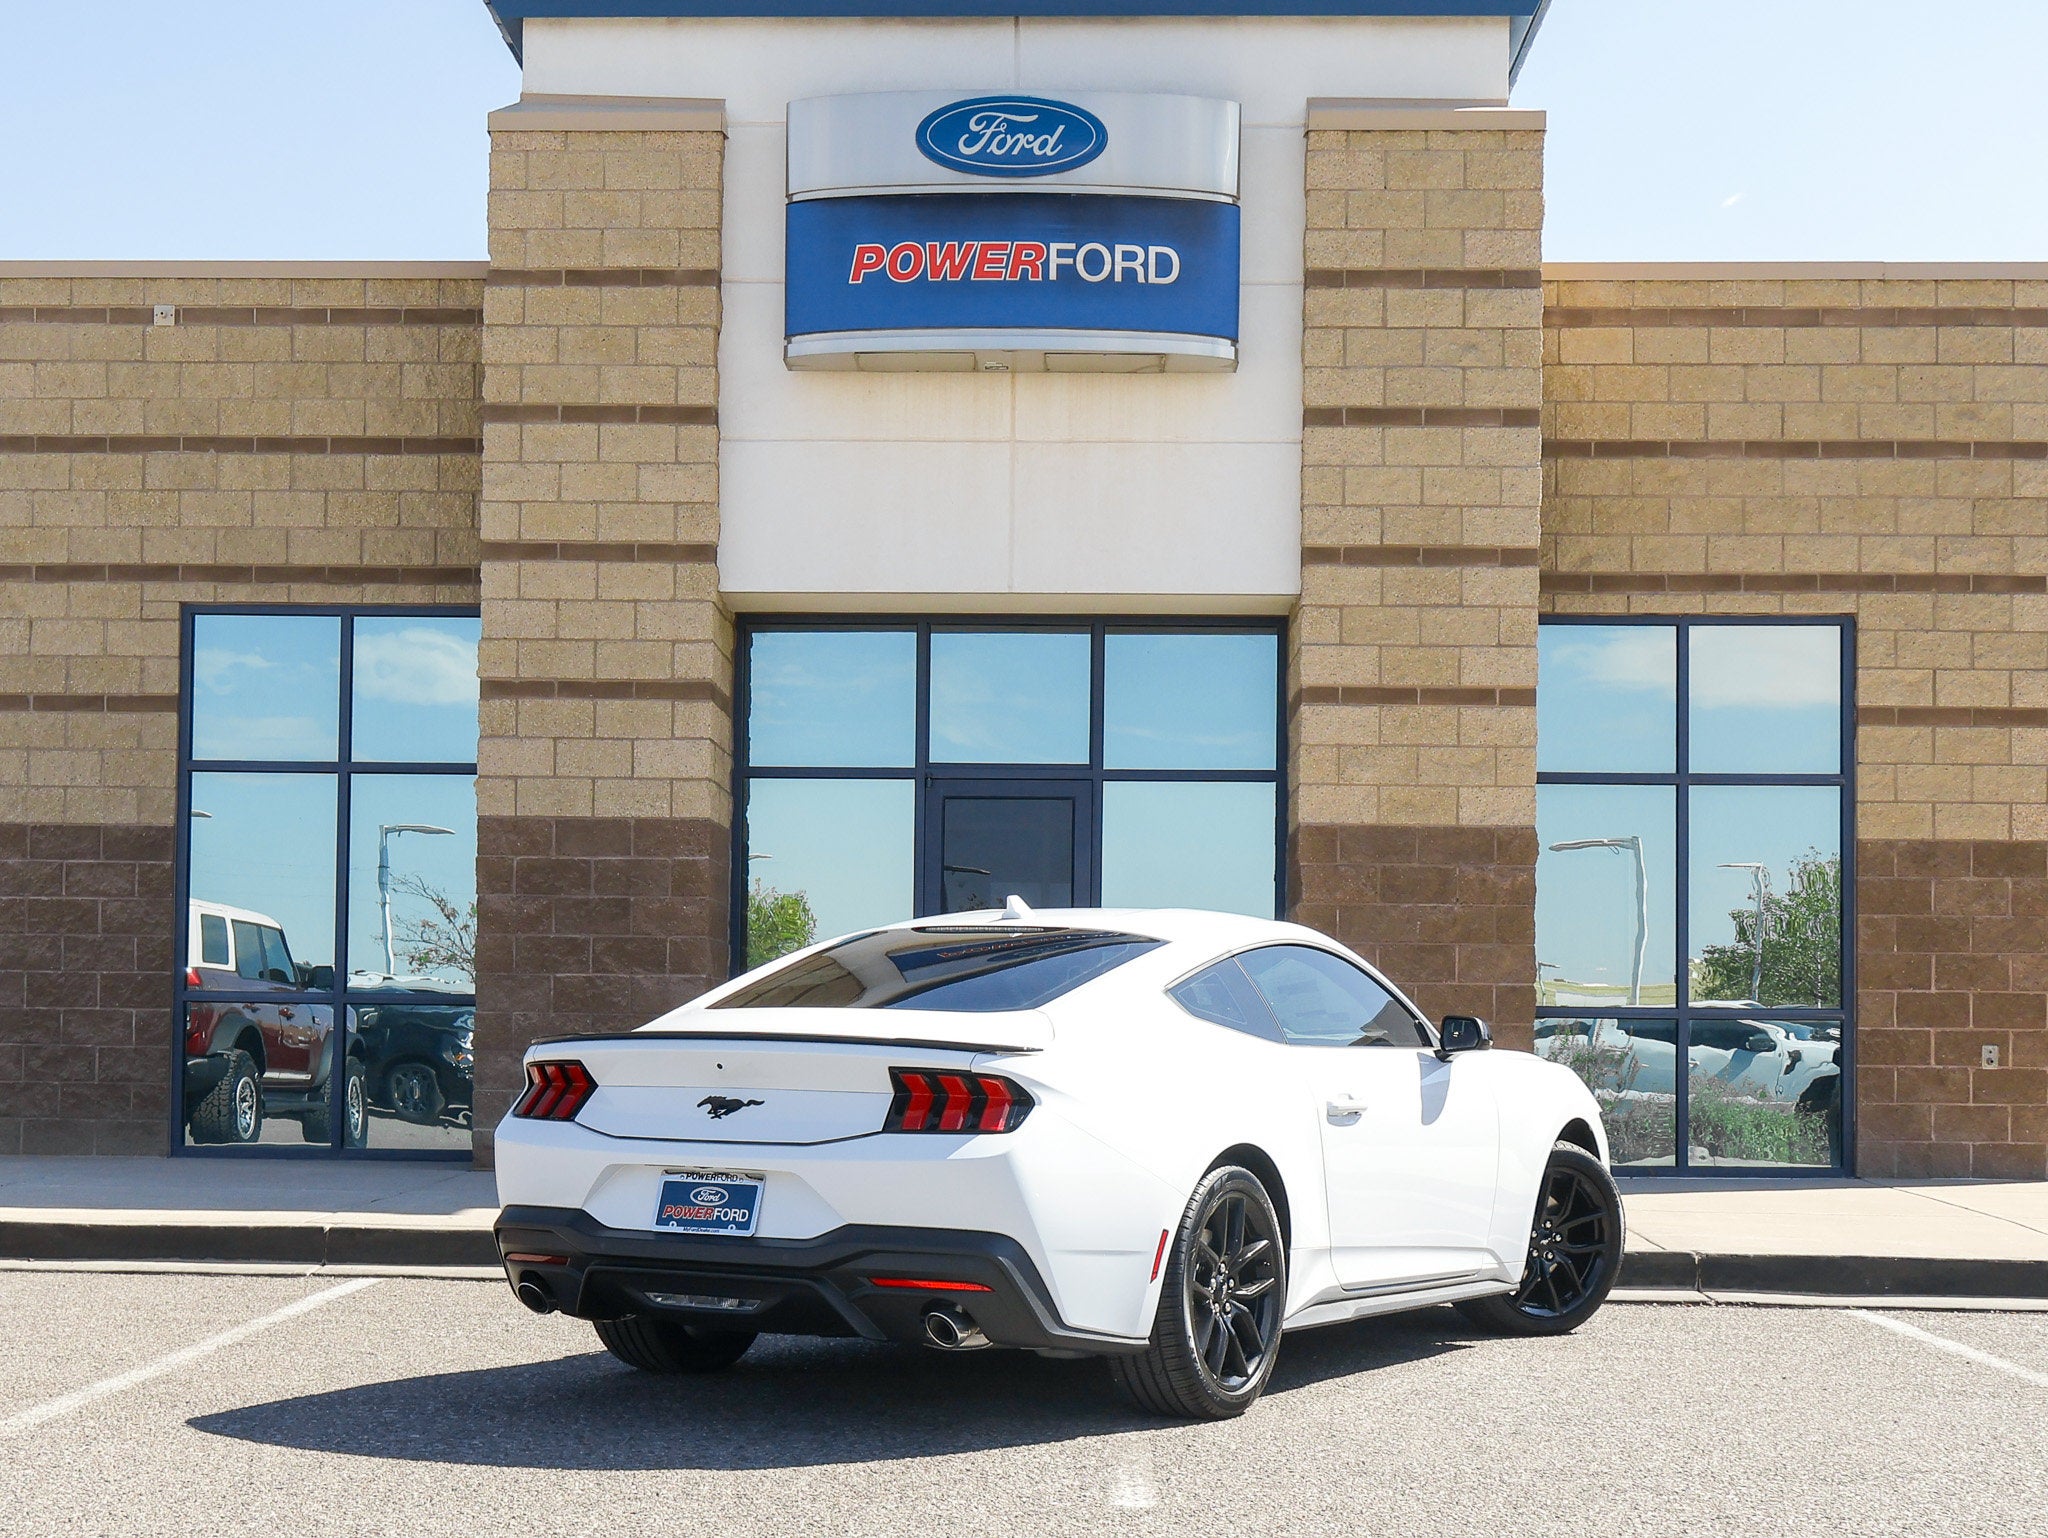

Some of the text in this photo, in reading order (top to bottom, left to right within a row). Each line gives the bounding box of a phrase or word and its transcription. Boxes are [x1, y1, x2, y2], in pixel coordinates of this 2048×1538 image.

[958, 111, 1066, 156] Ford
[848, 241, 1181, 284] POWERFORD
[685, 1172, 738, 1182] POWERFORD
[697, 1190, 721, 1202] Ford
[662, 1205, 749, 1222] POWERFORD
